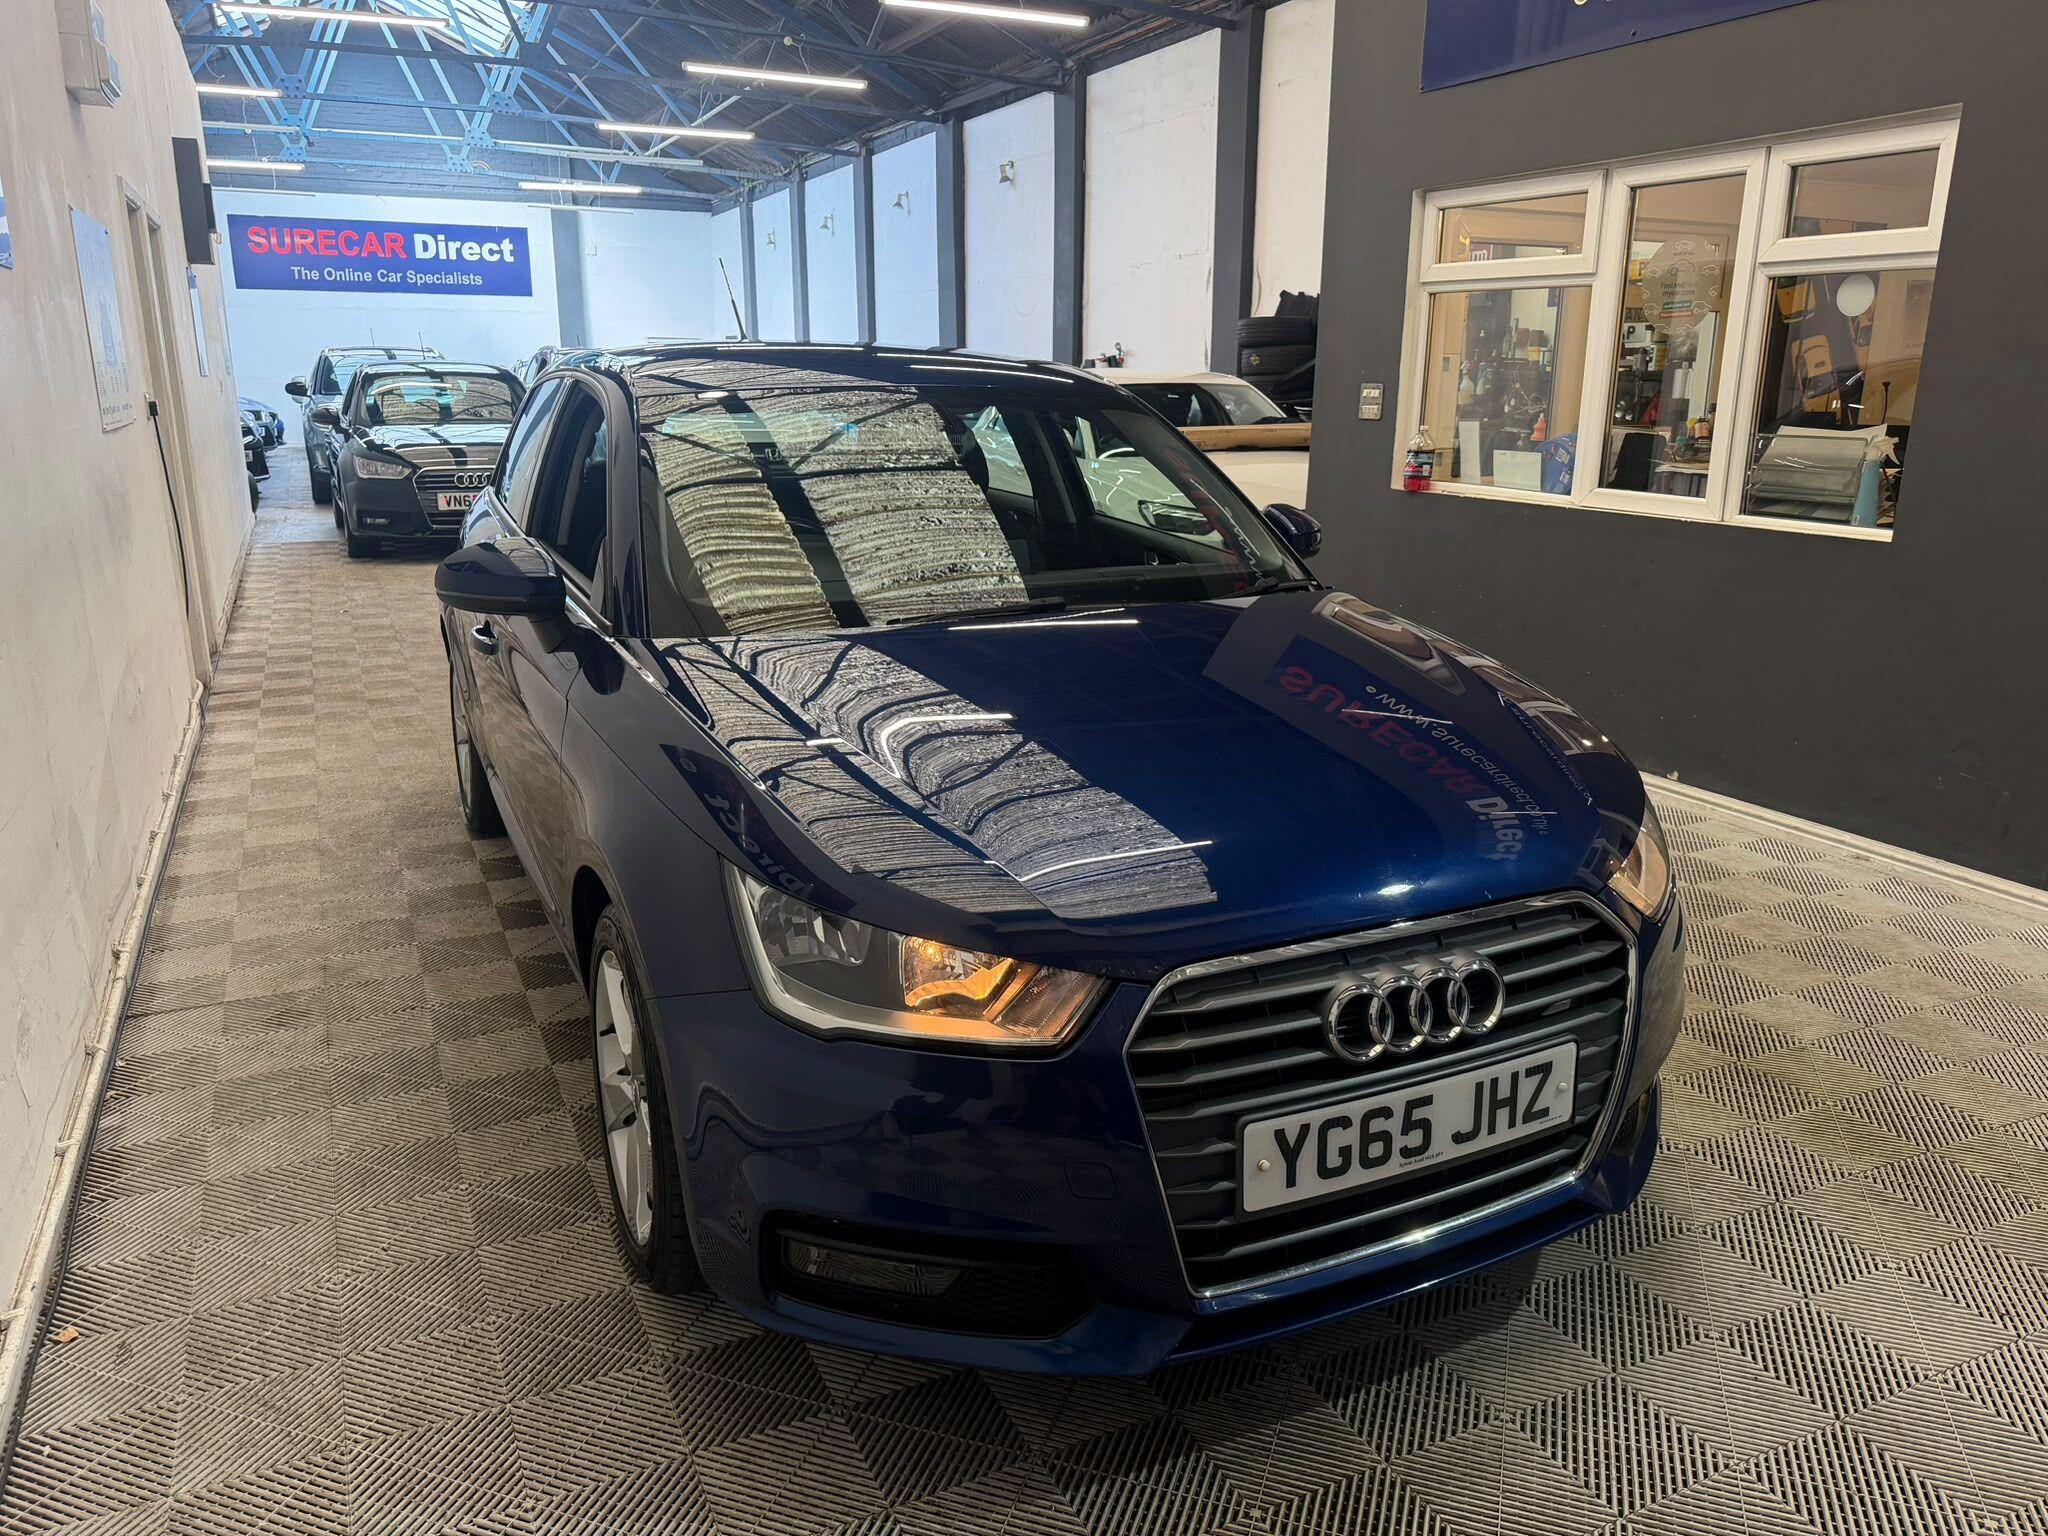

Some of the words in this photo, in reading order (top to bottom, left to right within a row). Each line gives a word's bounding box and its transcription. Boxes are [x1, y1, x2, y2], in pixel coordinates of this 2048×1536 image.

[247, 226, 408, 259] SURECAR
[413, 233, 515, 263] Direct
[290, 266, 320, 281] The
[323, 267, 372, 283] Online
[376, 269, 402, 284] Car
[406, 270, 483, 286] Specialists
[1273, 1094, 1435, 1189] YG65
[1451, 1060, 1554, 1146] JHZ
